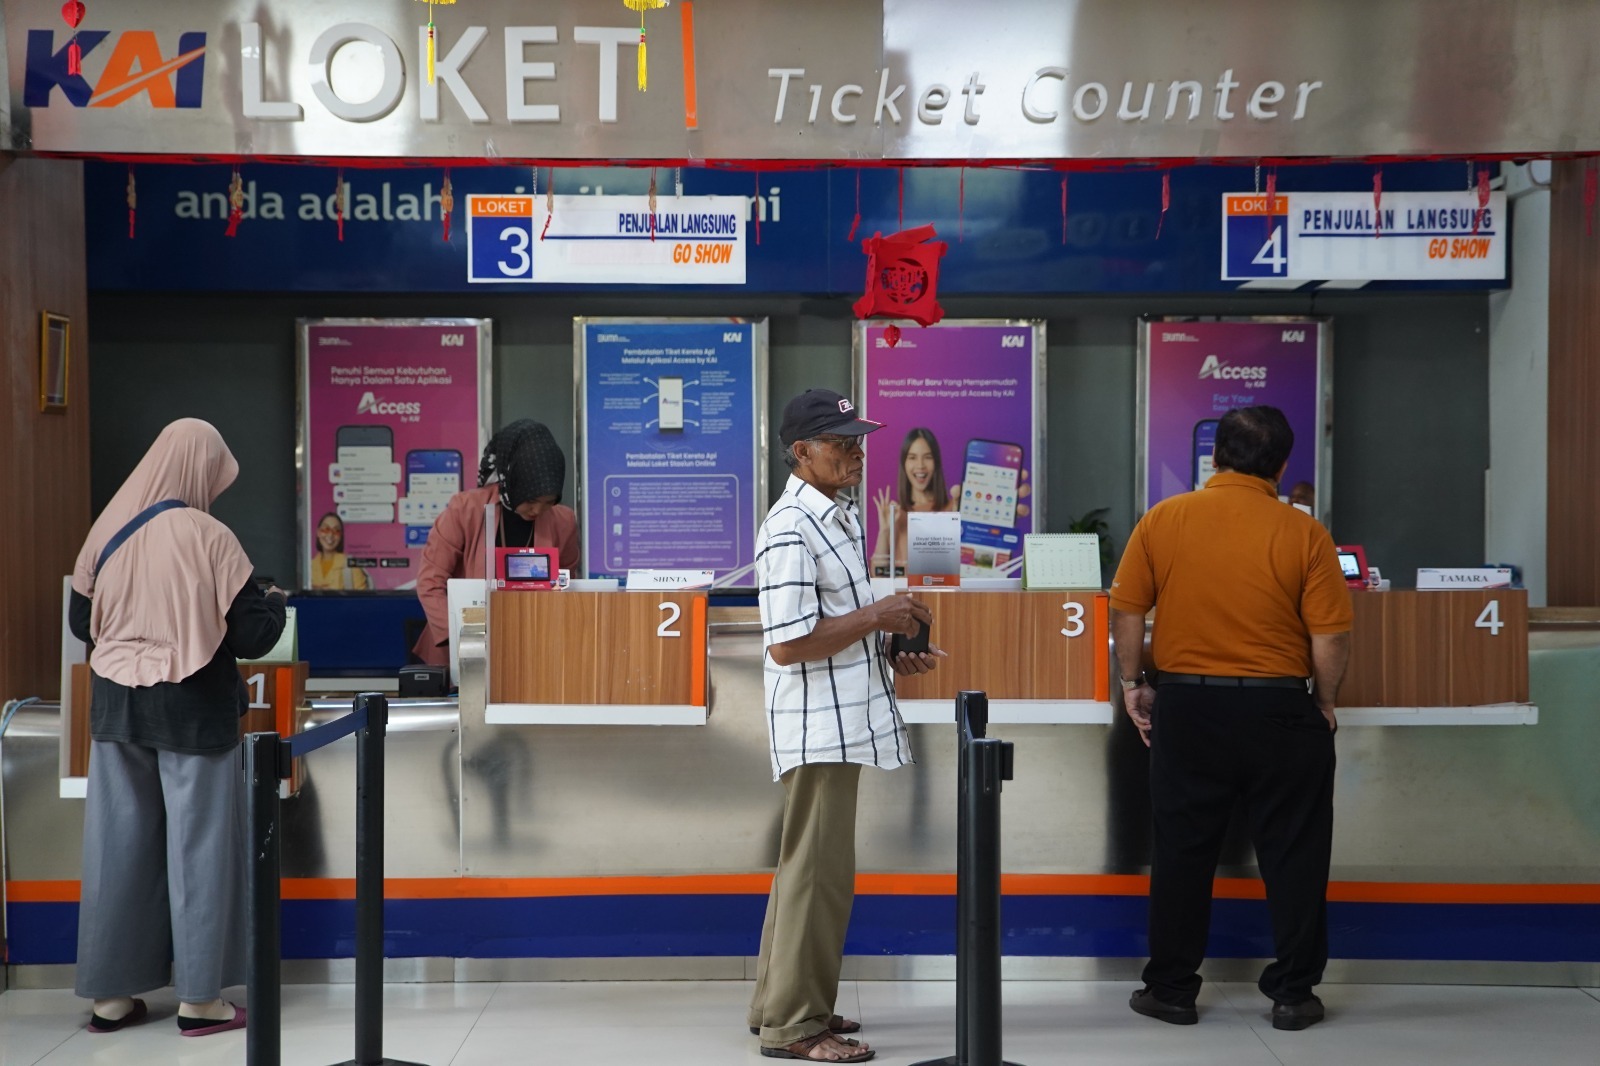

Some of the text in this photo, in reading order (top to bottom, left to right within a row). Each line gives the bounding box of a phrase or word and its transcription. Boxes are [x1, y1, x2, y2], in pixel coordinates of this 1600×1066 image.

[23, 29, 207, 108] KAI
[240, 22, 646, 123] LOKET
[768, 66, 1322, 125] Ticket Counter
[174, 181, 285, 219] anda
[298, 182, 449, 221] adalah
[477, 200, 527, 213] LOKET
[618, 212, 737, 235] PENJUALAN LANGSUNG
[1303, 209, 1394, 231] PENJUALAN
[497, 226, 531, 277] 3
[673, 243, 733, 264] GO SHOW
[1251, 224, 1287, 274] 4
[1428, 238, 1491, 259] GO SHOW
[440, 333, 465, 347] KAI
[722, 332, 743, 343] KAI
[1001, 334, 1026, 348] KAI
[1281, 330, 1306, 343] KAI
[623, 348, 716, 357] Pembatalan Tiket Kereta Api
[646, 357, 672, 365] Aplikasi
[697, 357, 706, 365] by
[331, 366, 446, 376] Penuhi Semua Kebutuhan
[1198, 354, 1268, 380] Access
[331, 376, 453, 386] Hanya Dalam Satu Aplikasi
[878, 378, 1018, 388] Nikmati Fitur Baru Yang Mempermudah
[357, 391, 421, 415] Access
[879, 389, 1015, 399] Perjalanan Anda Hanya di Access by KAI
[1213, 394, 1255, 404] For Your
[625, 452, 718, 461] Pembatalan Tiket Kereta Api
[627, 460, 717, 468] Melalui Loket Stasiun Online
[1439, 574, 1489, 582] TAMARA
[656, 601, 681, 637] 2
[1060, 601, 1085, 637] 3
[1474, 599, 1505, 636] 4
[246, 672, 272, 709] 1
